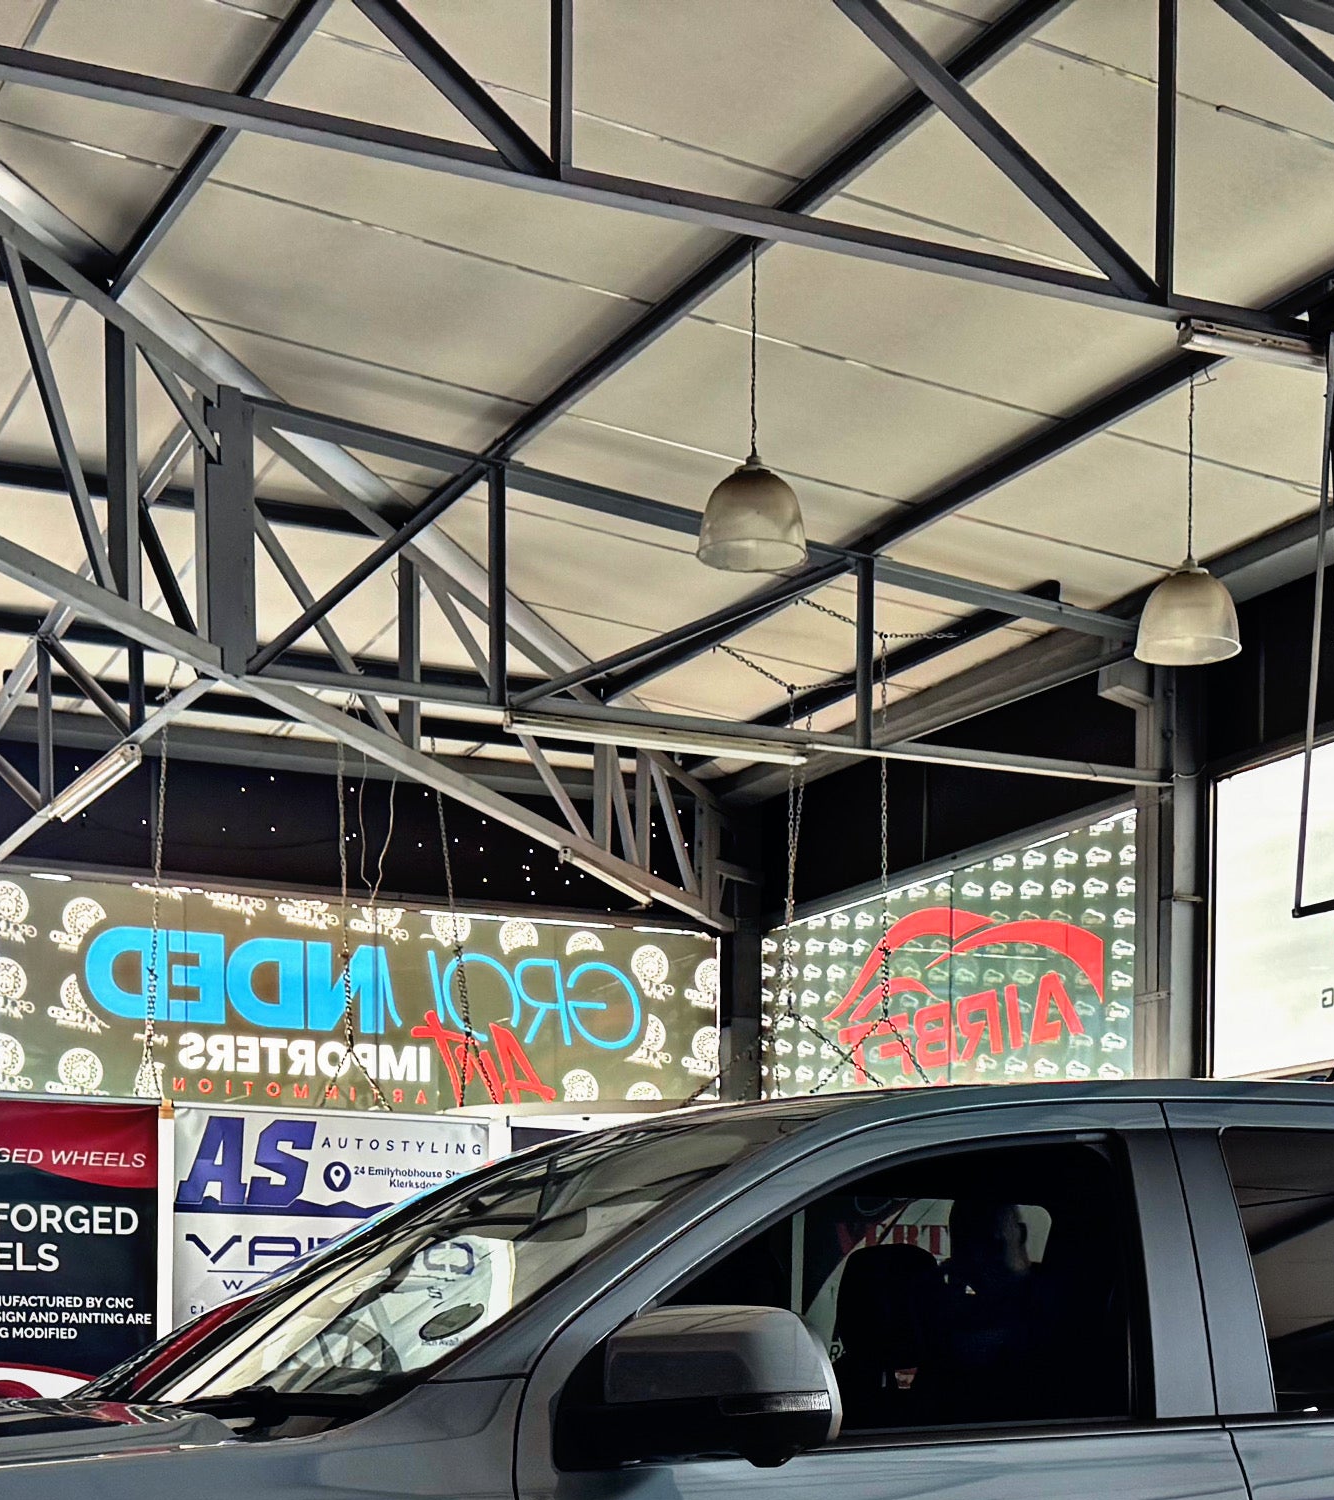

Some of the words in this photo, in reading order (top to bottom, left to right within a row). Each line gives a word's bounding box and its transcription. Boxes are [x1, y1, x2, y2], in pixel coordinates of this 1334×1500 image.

[321, 1136, 483, 1156] AUTOSTYLING
[51, 1150, 147, 1168] WHEELS
[176, 1116, 317, 1206] AS
[353, 1166, 366, 1176] 24
[85, 1297, 104, 1309] BY
[105, 1297, 134, 1309] CNC
[28, 1312, 59, 1324] AND
[62, 1312, 124, 1325] PAINTING
[126, 1313, 152, 1325] ARE
[12, 1327, 78, 1340] MODIFIED
